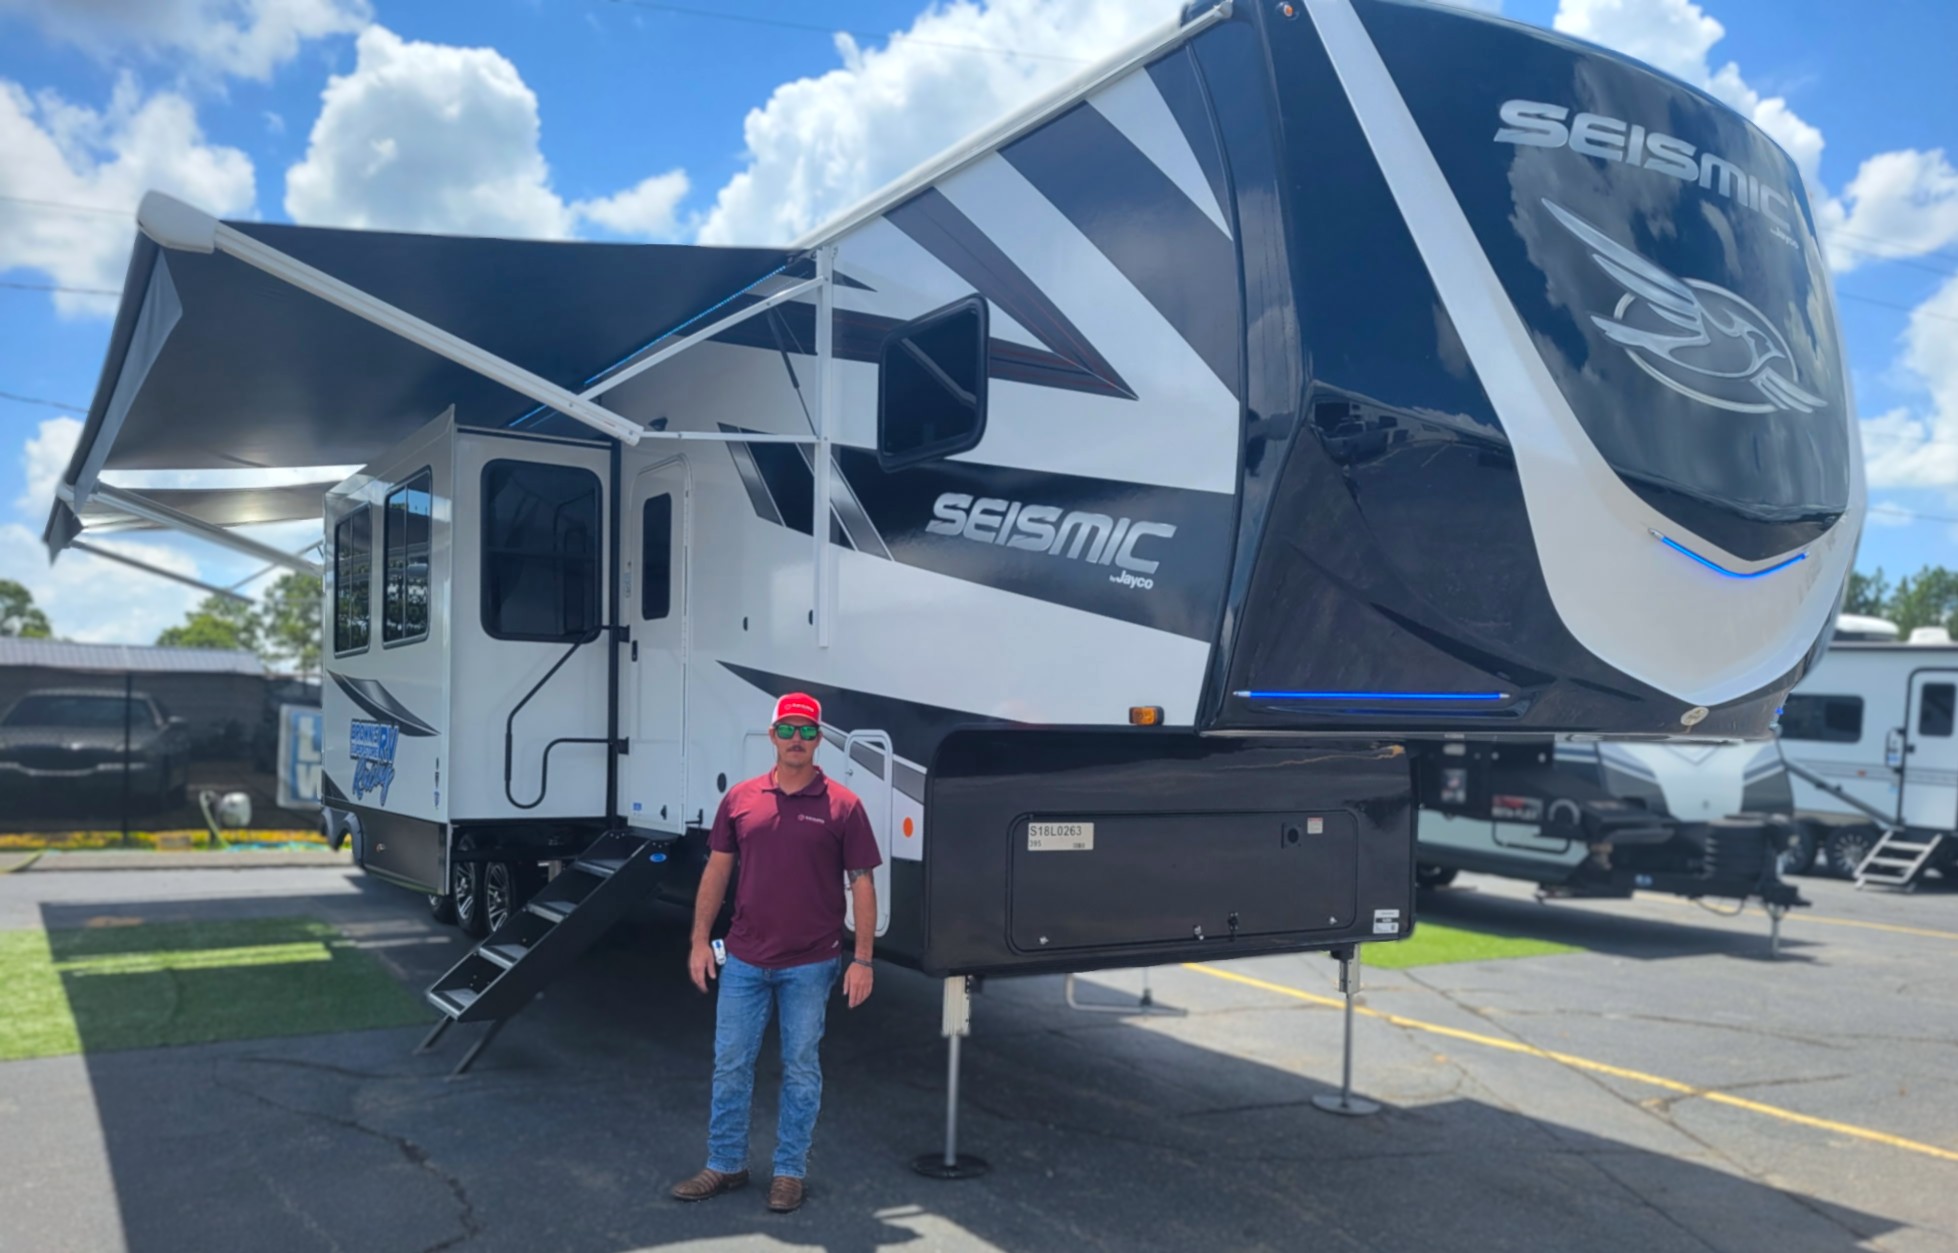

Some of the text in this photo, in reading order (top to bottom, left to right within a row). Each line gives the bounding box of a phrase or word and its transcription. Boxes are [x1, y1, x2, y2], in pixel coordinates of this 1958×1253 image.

[1494, 99, 1791, 230] SEISMIC
[925, 492, 1178, 574] SEISMIC
[1116, 569, 1154, 590] Jayco
[1030, 825, 1082, 837] S18L0263
